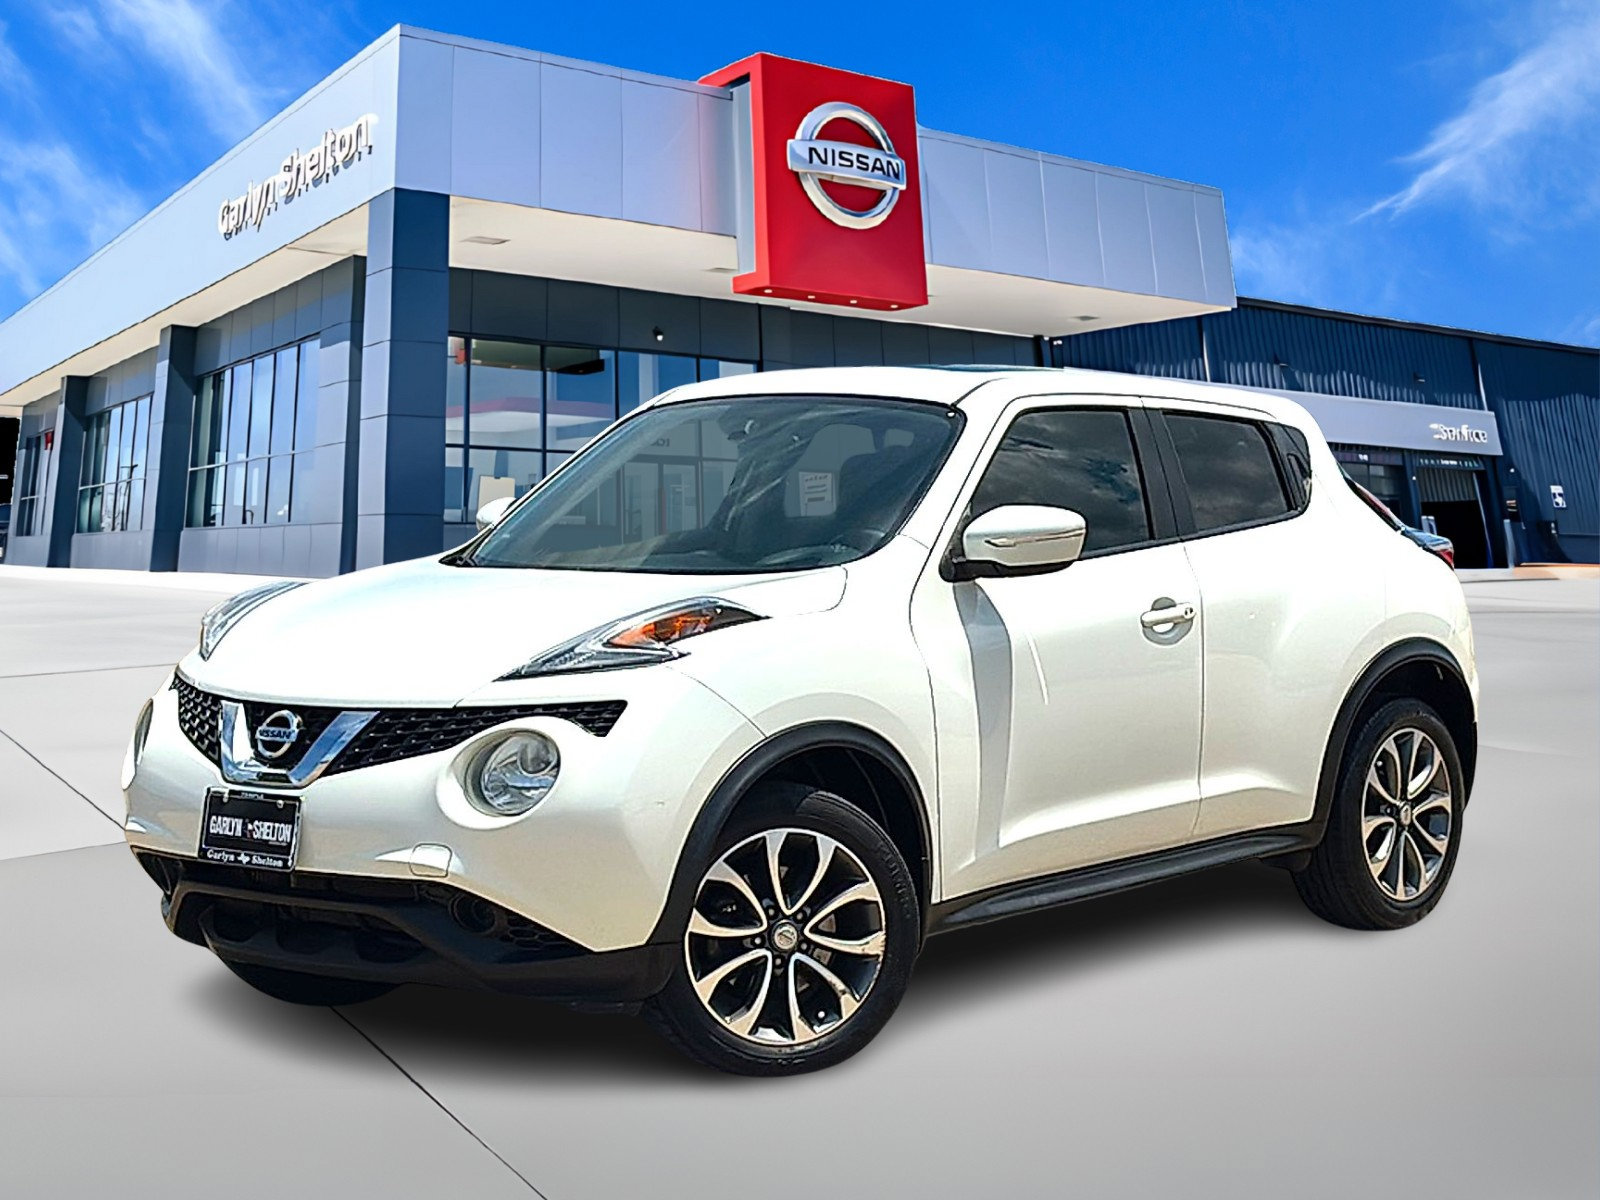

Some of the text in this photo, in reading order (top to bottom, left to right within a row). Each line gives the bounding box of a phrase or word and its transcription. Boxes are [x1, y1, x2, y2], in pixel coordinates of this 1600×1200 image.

[279, 114, 378, 202] Shelton
[808, 146, 900, 180] NISSAN
[1429, 423, 1488, 443] Service
[258, 728, 296, 740] NISSAN
[209, 815, 293, 843] GARLYN SHELTON
[251, 855, 284, 867] Shelton
